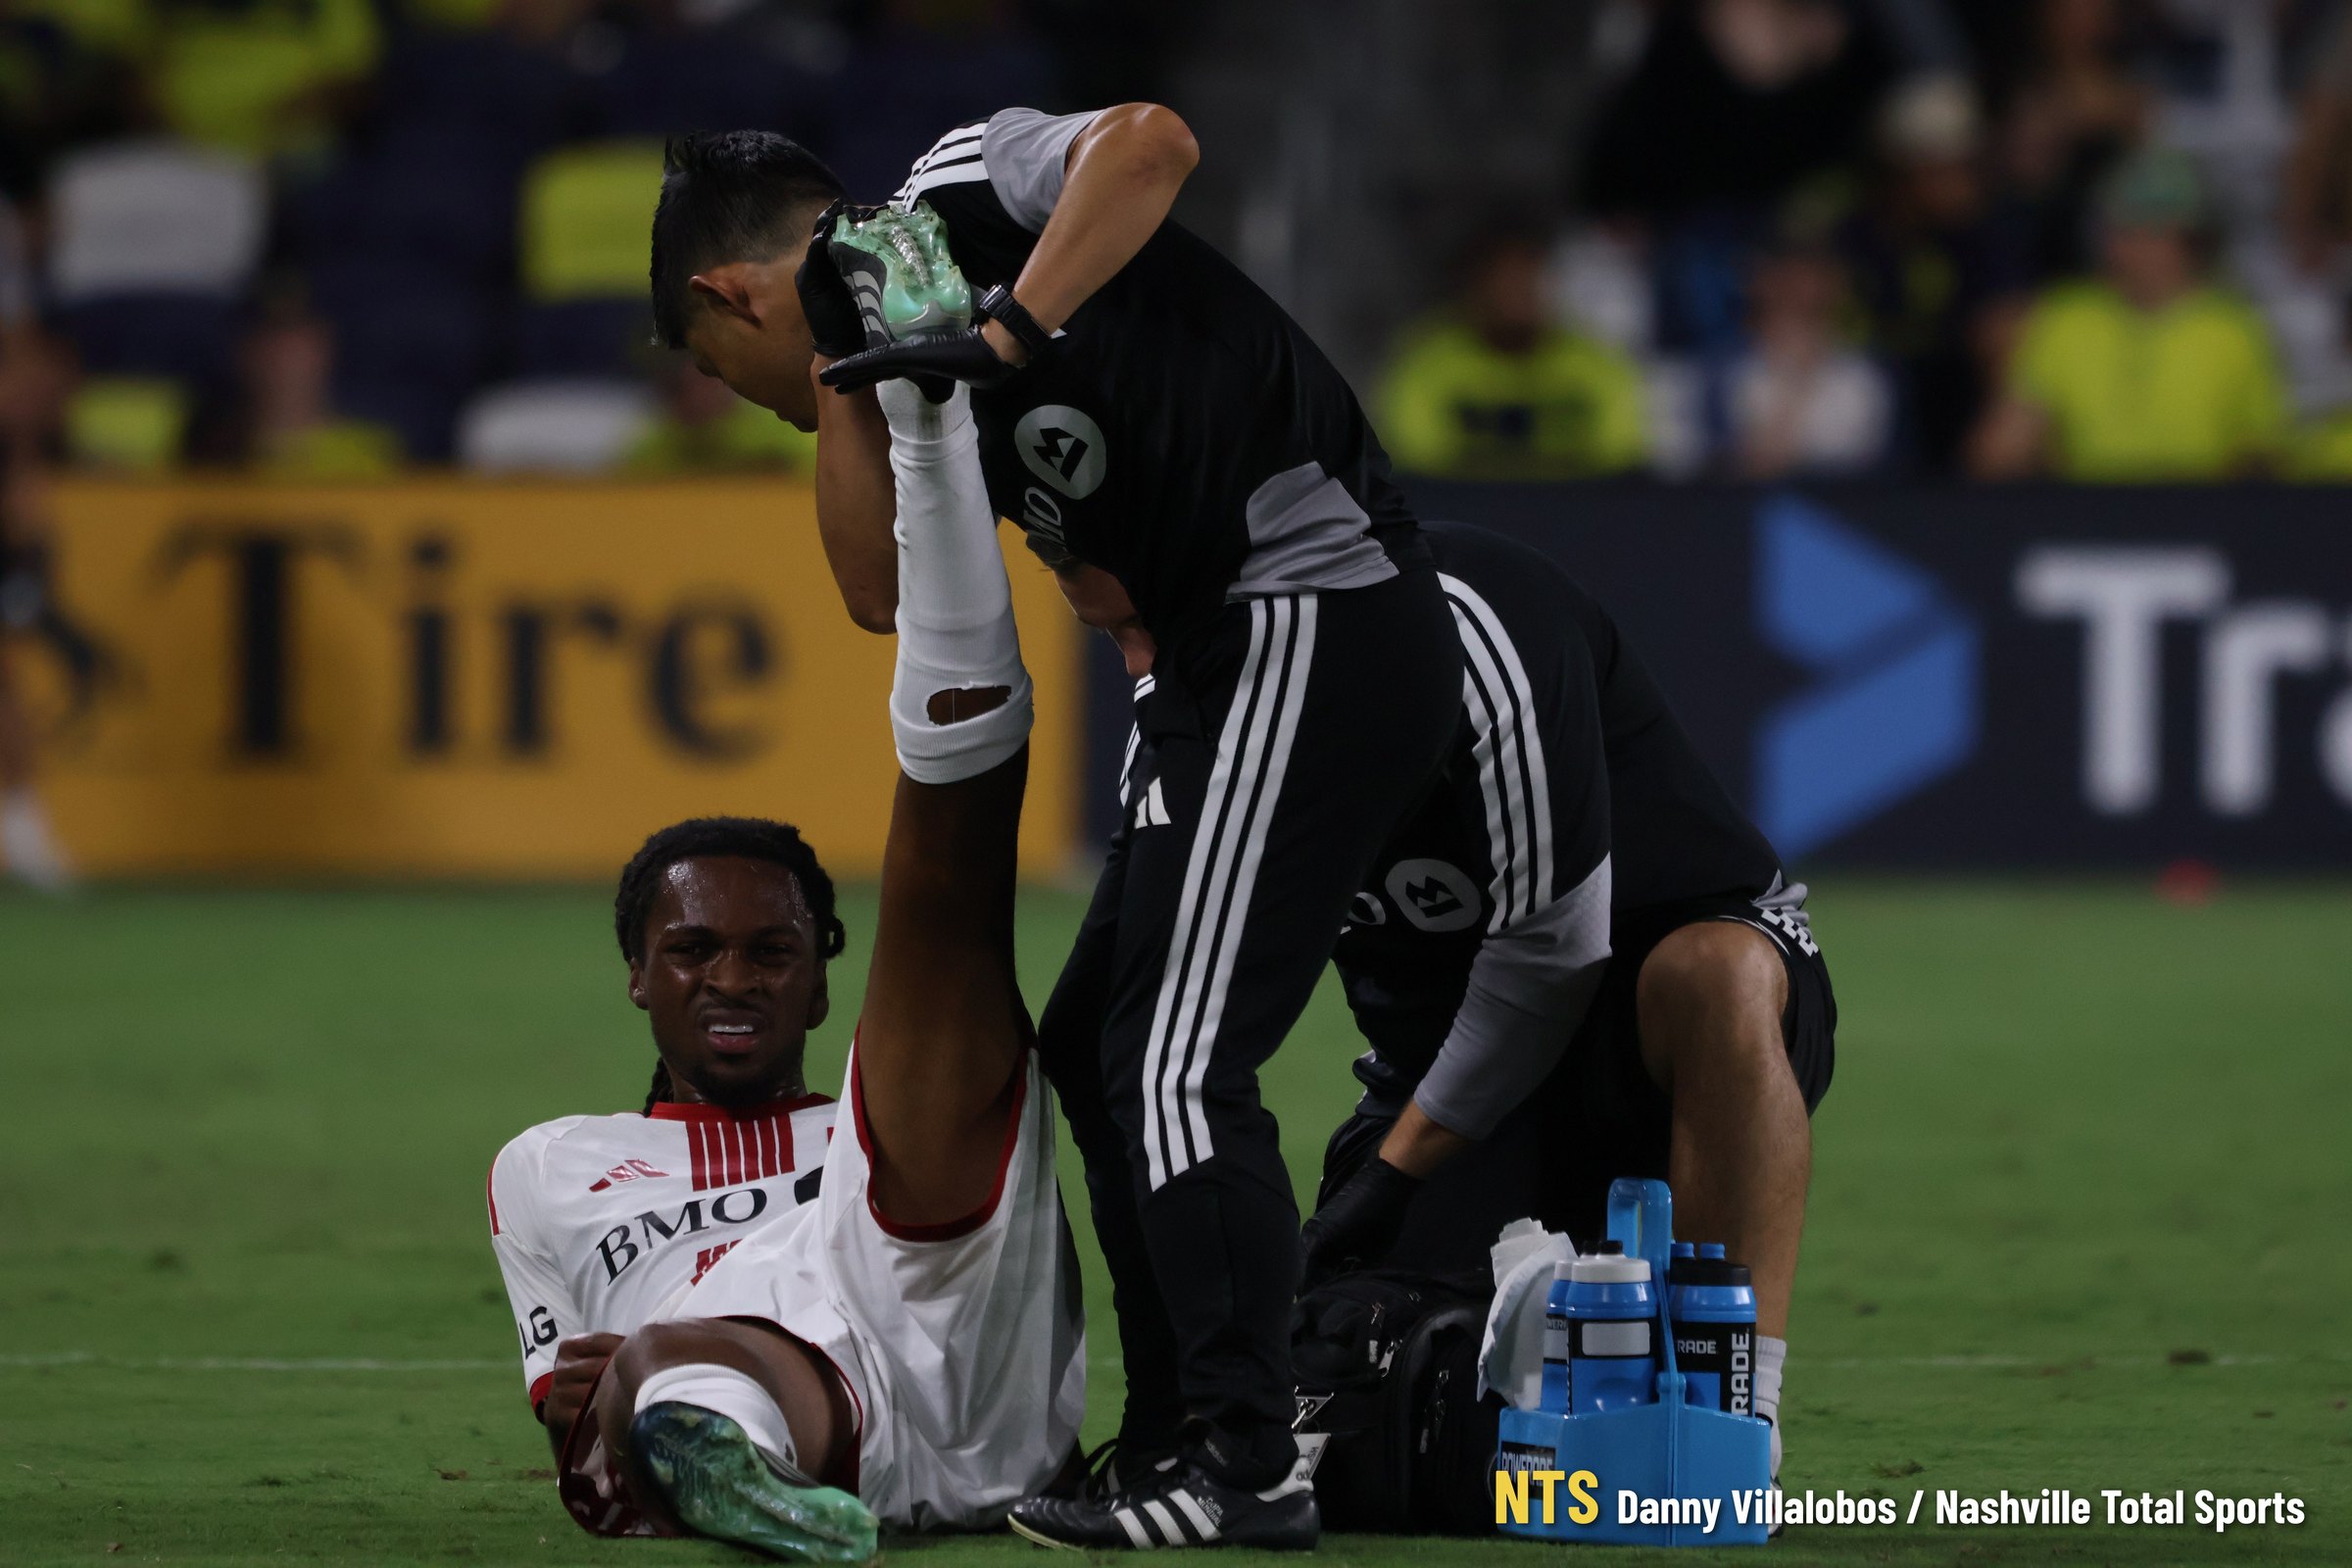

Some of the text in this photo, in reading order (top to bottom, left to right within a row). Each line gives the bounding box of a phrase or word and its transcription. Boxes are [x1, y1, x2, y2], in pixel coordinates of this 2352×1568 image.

[145, 517, 782, 762] Tire
[2017, 544, 2352, 815] Tr
[596, 1188, 768, 1287] BMO
[518, 1305, 559, 1359] LG
[1731, 1333, 1750, 1416] RADE
